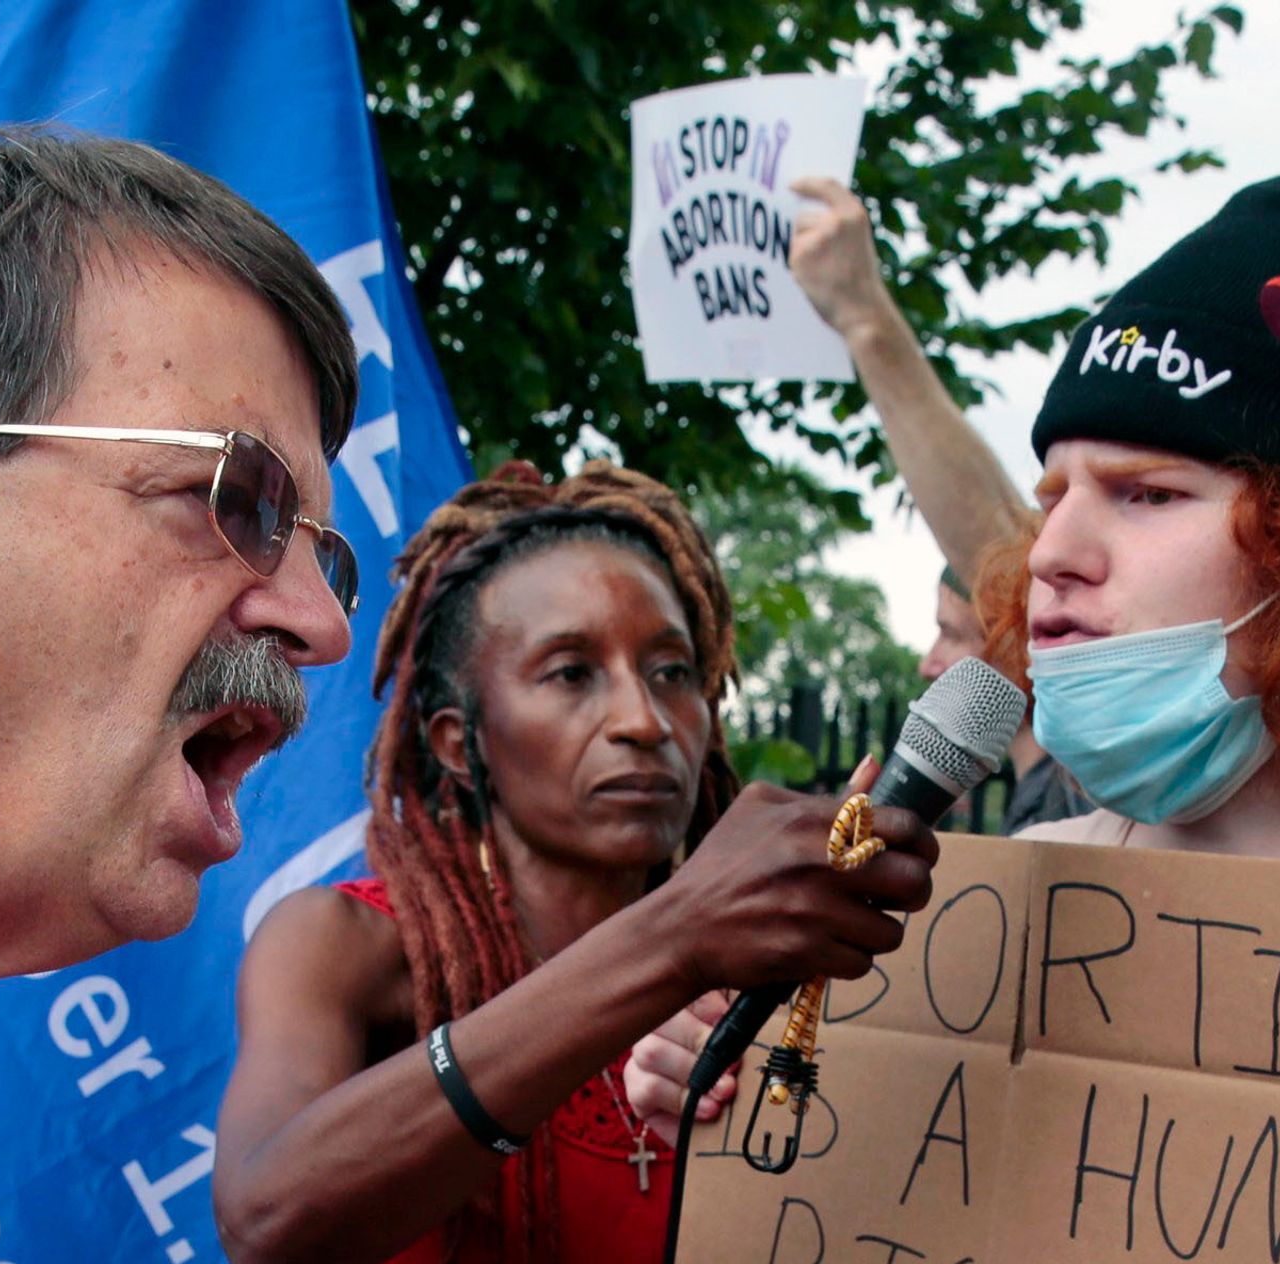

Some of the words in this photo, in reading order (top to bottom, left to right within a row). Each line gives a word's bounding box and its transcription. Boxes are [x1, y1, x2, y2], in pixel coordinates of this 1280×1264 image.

[679, 117, 749, 178] STOP
[660, 191, 791, 278] ABORTION
[694, 262, 770, 322] BANS
[1080, 325, 1232, 399] Kirby
[901, 1062, 969, 1205] A
